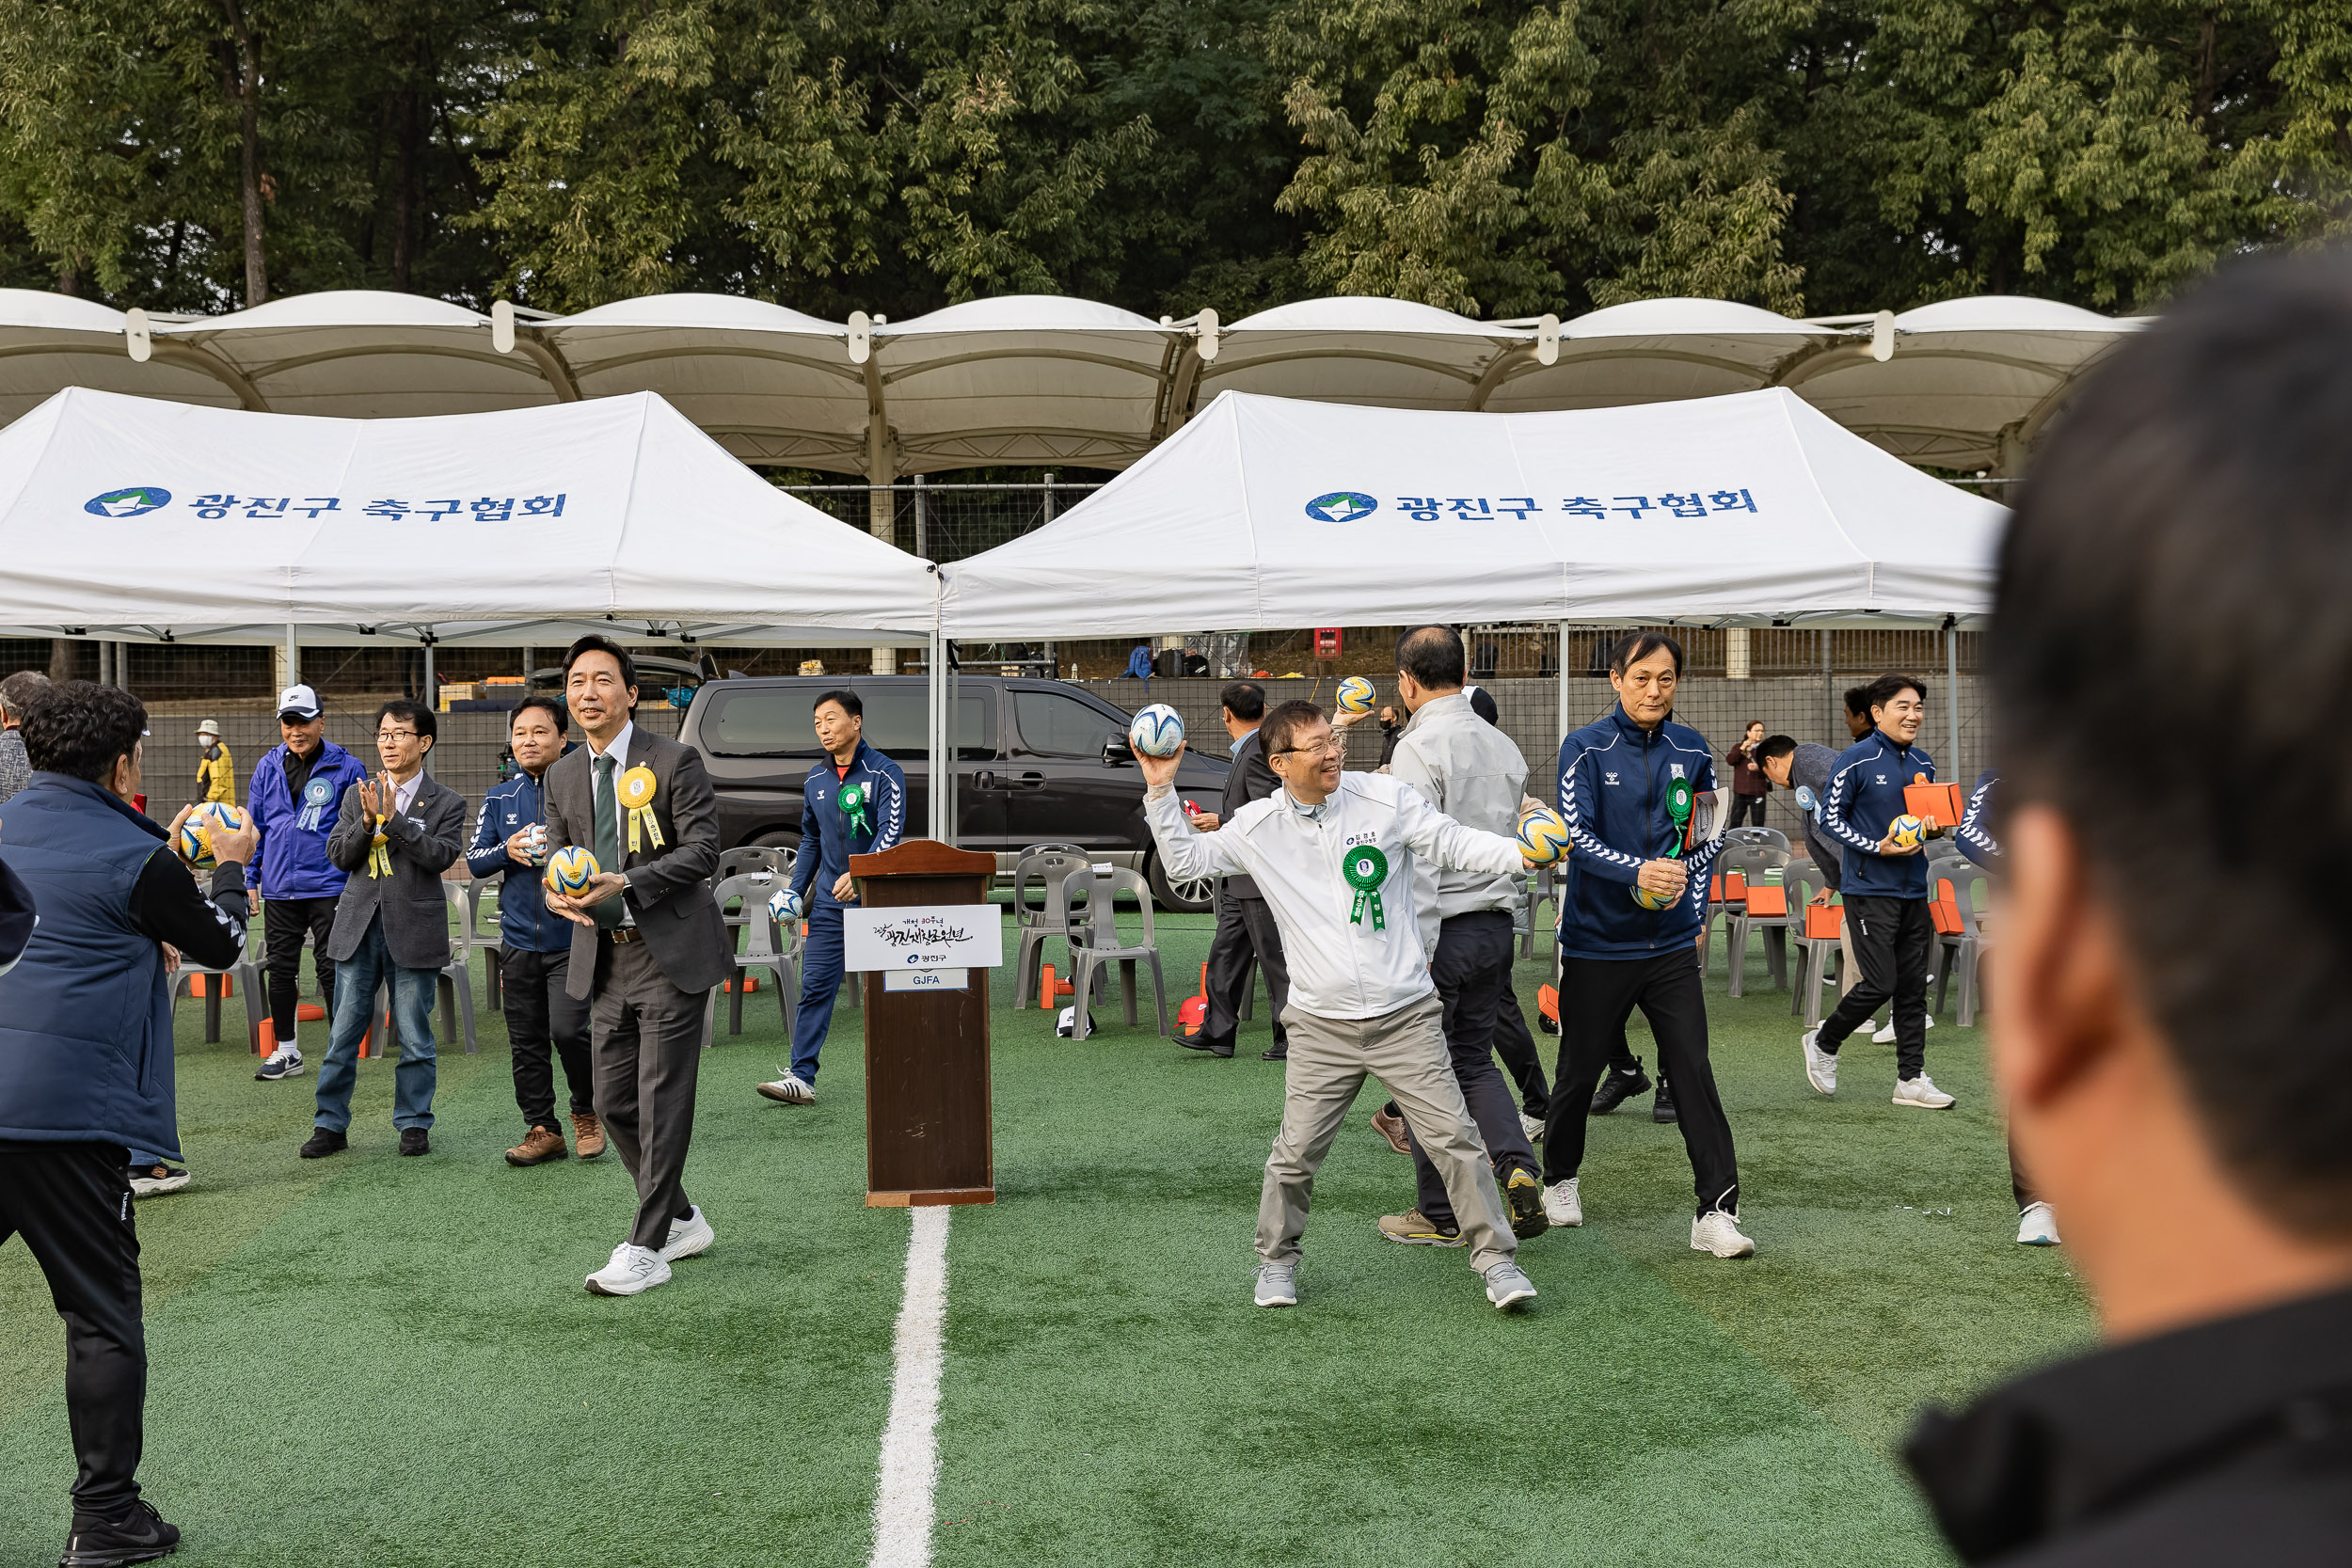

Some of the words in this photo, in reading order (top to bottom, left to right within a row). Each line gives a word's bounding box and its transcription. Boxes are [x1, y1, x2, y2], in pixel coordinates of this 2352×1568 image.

[188, 494, 342, 519] 광진구
[361, 493, 567, 522] 축구협회
[1396, 496, 1543, 521] 광진구
[1561, 488, 1758, 520] 축구협회
[902, 918, 918, 927] 개청
[921, 915, 944, 927] 30주년
[921, 954, 946, 962] 광진구
[913, 975, 940, 985] GJFA
